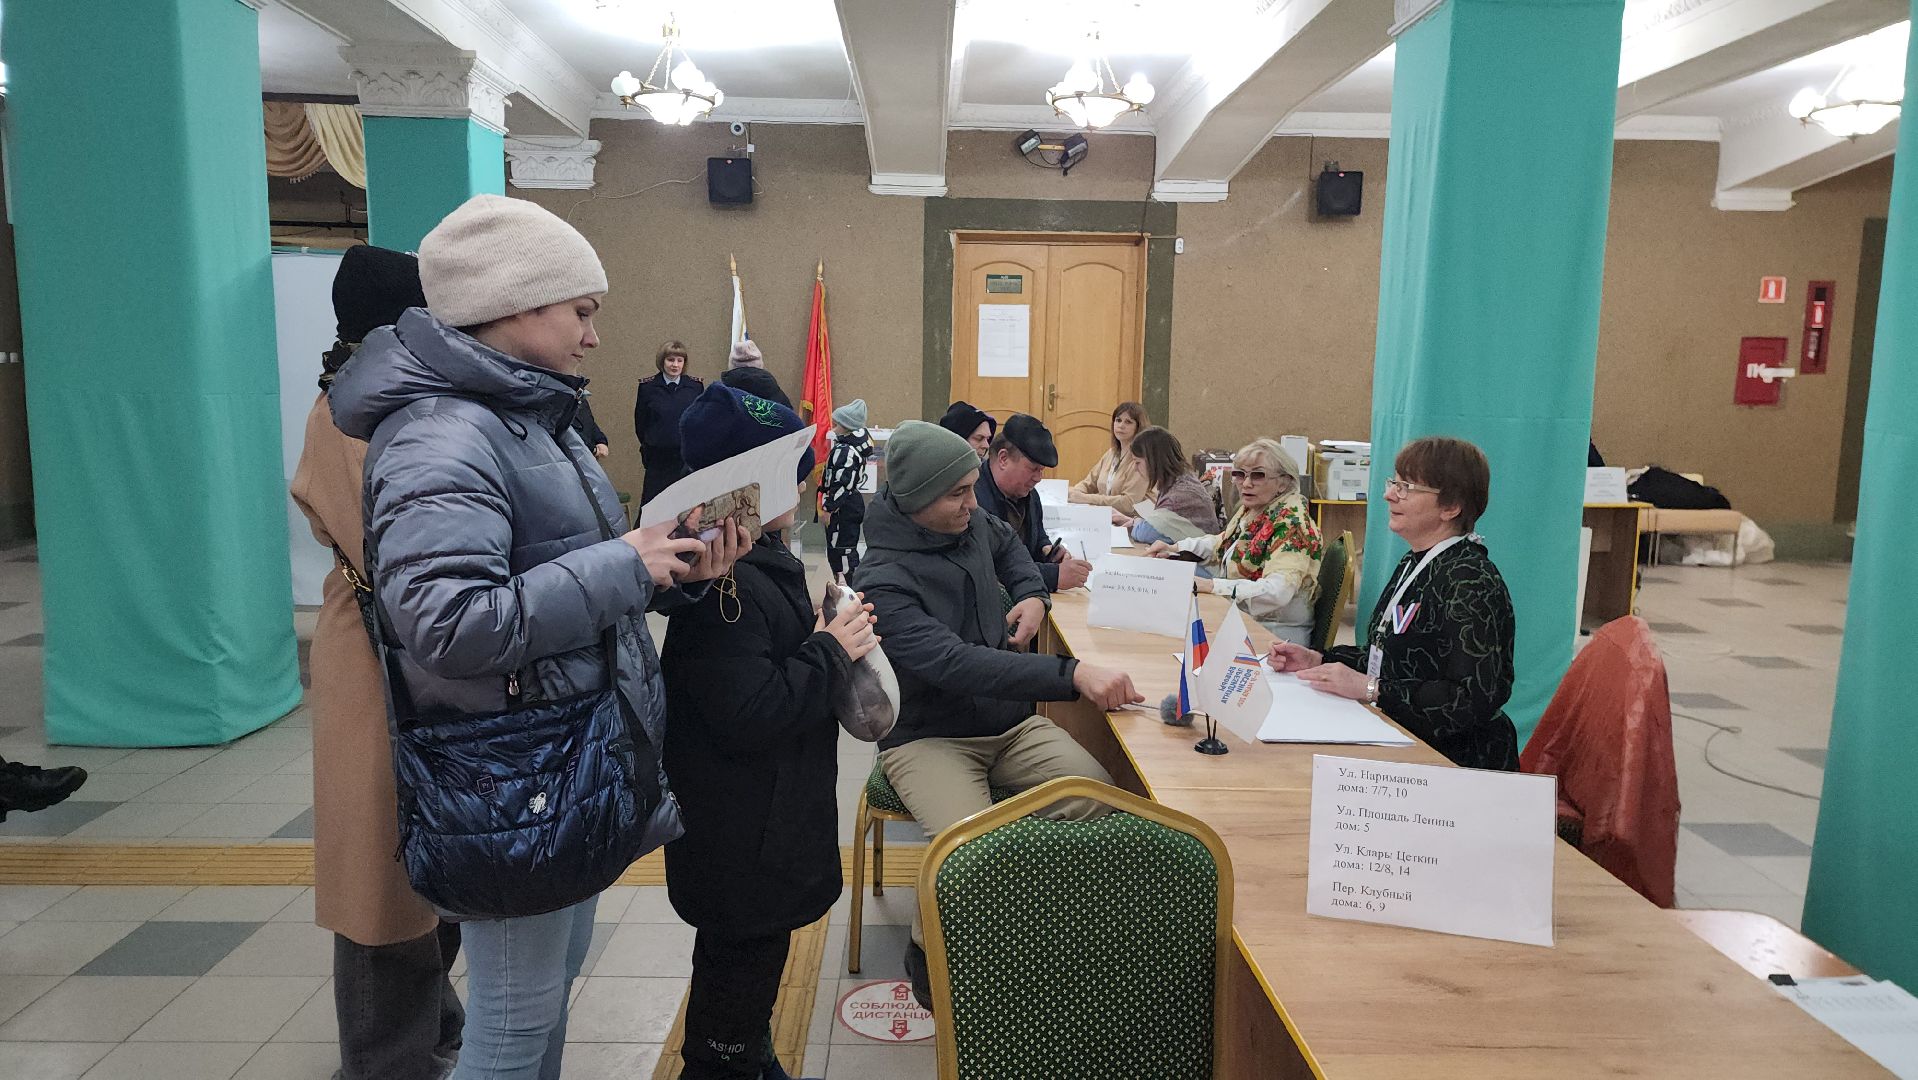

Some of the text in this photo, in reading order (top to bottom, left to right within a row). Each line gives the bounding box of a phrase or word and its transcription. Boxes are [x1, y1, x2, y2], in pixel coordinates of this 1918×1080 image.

[1339, 767, 1428, 787] Ул. Нариманова
[1337, 783, 1408, 798] дома: 7/7, 10
[1337, 805, 1455, 828] Ул. Площадь Ленина
[1335, 821, 1370, 832] дом: 5
[1335, 843, 1438, 865] Ул. Клары Цеткин
[1333, 860, 1410, 876] дома: 12/8, 14
[1332, 881, 1412, 901] Пер. Клубный
[1331, 898, 1386, 912] дома: 6, 9
[850, 1002, 923, 1010] СОБЛЮДА
[853, 1011, 932, 1020] ДИСТАНЦИ
